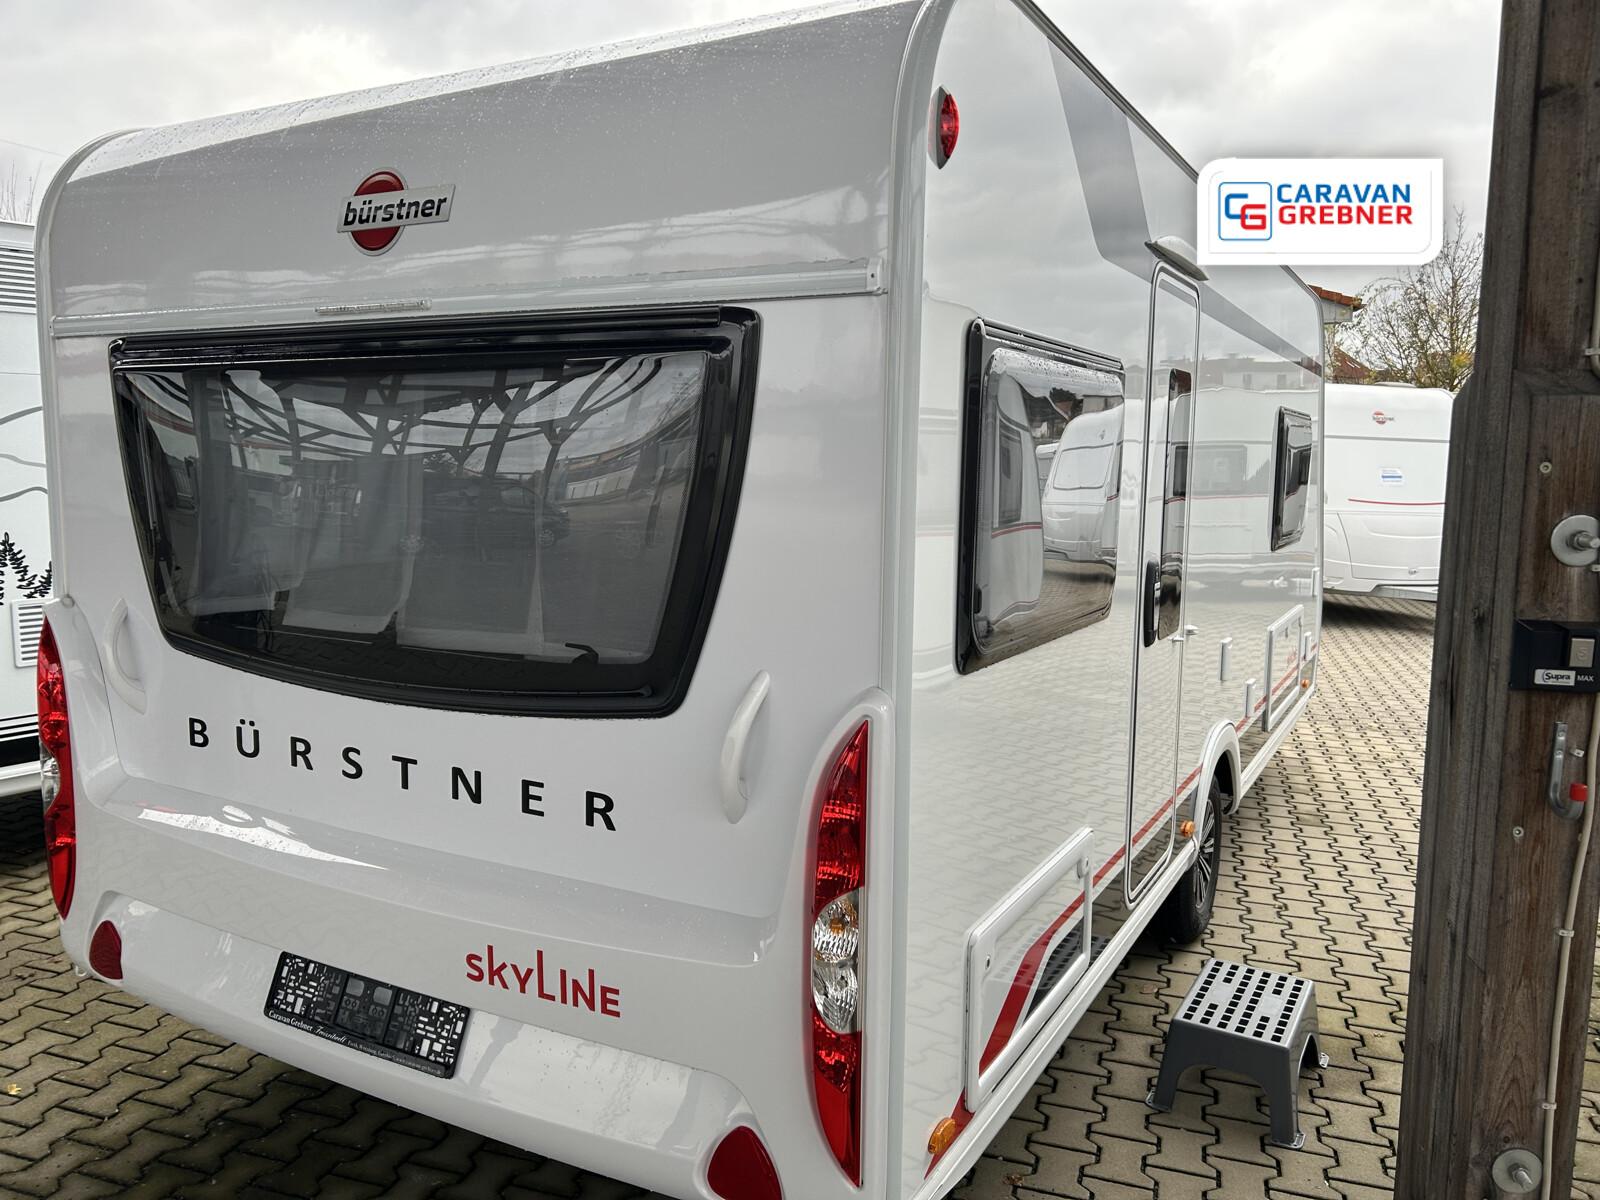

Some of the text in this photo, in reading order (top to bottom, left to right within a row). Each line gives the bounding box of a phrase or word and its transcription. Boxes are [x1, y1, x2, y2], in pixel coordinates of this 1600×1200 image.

[343, 196, 448, 226] bürstner
[1544, 672, 1571, 681] Supra
[188, 717, 617, 832] BÜRSTNER
[268, 1010, 291, 1023] Caravan
